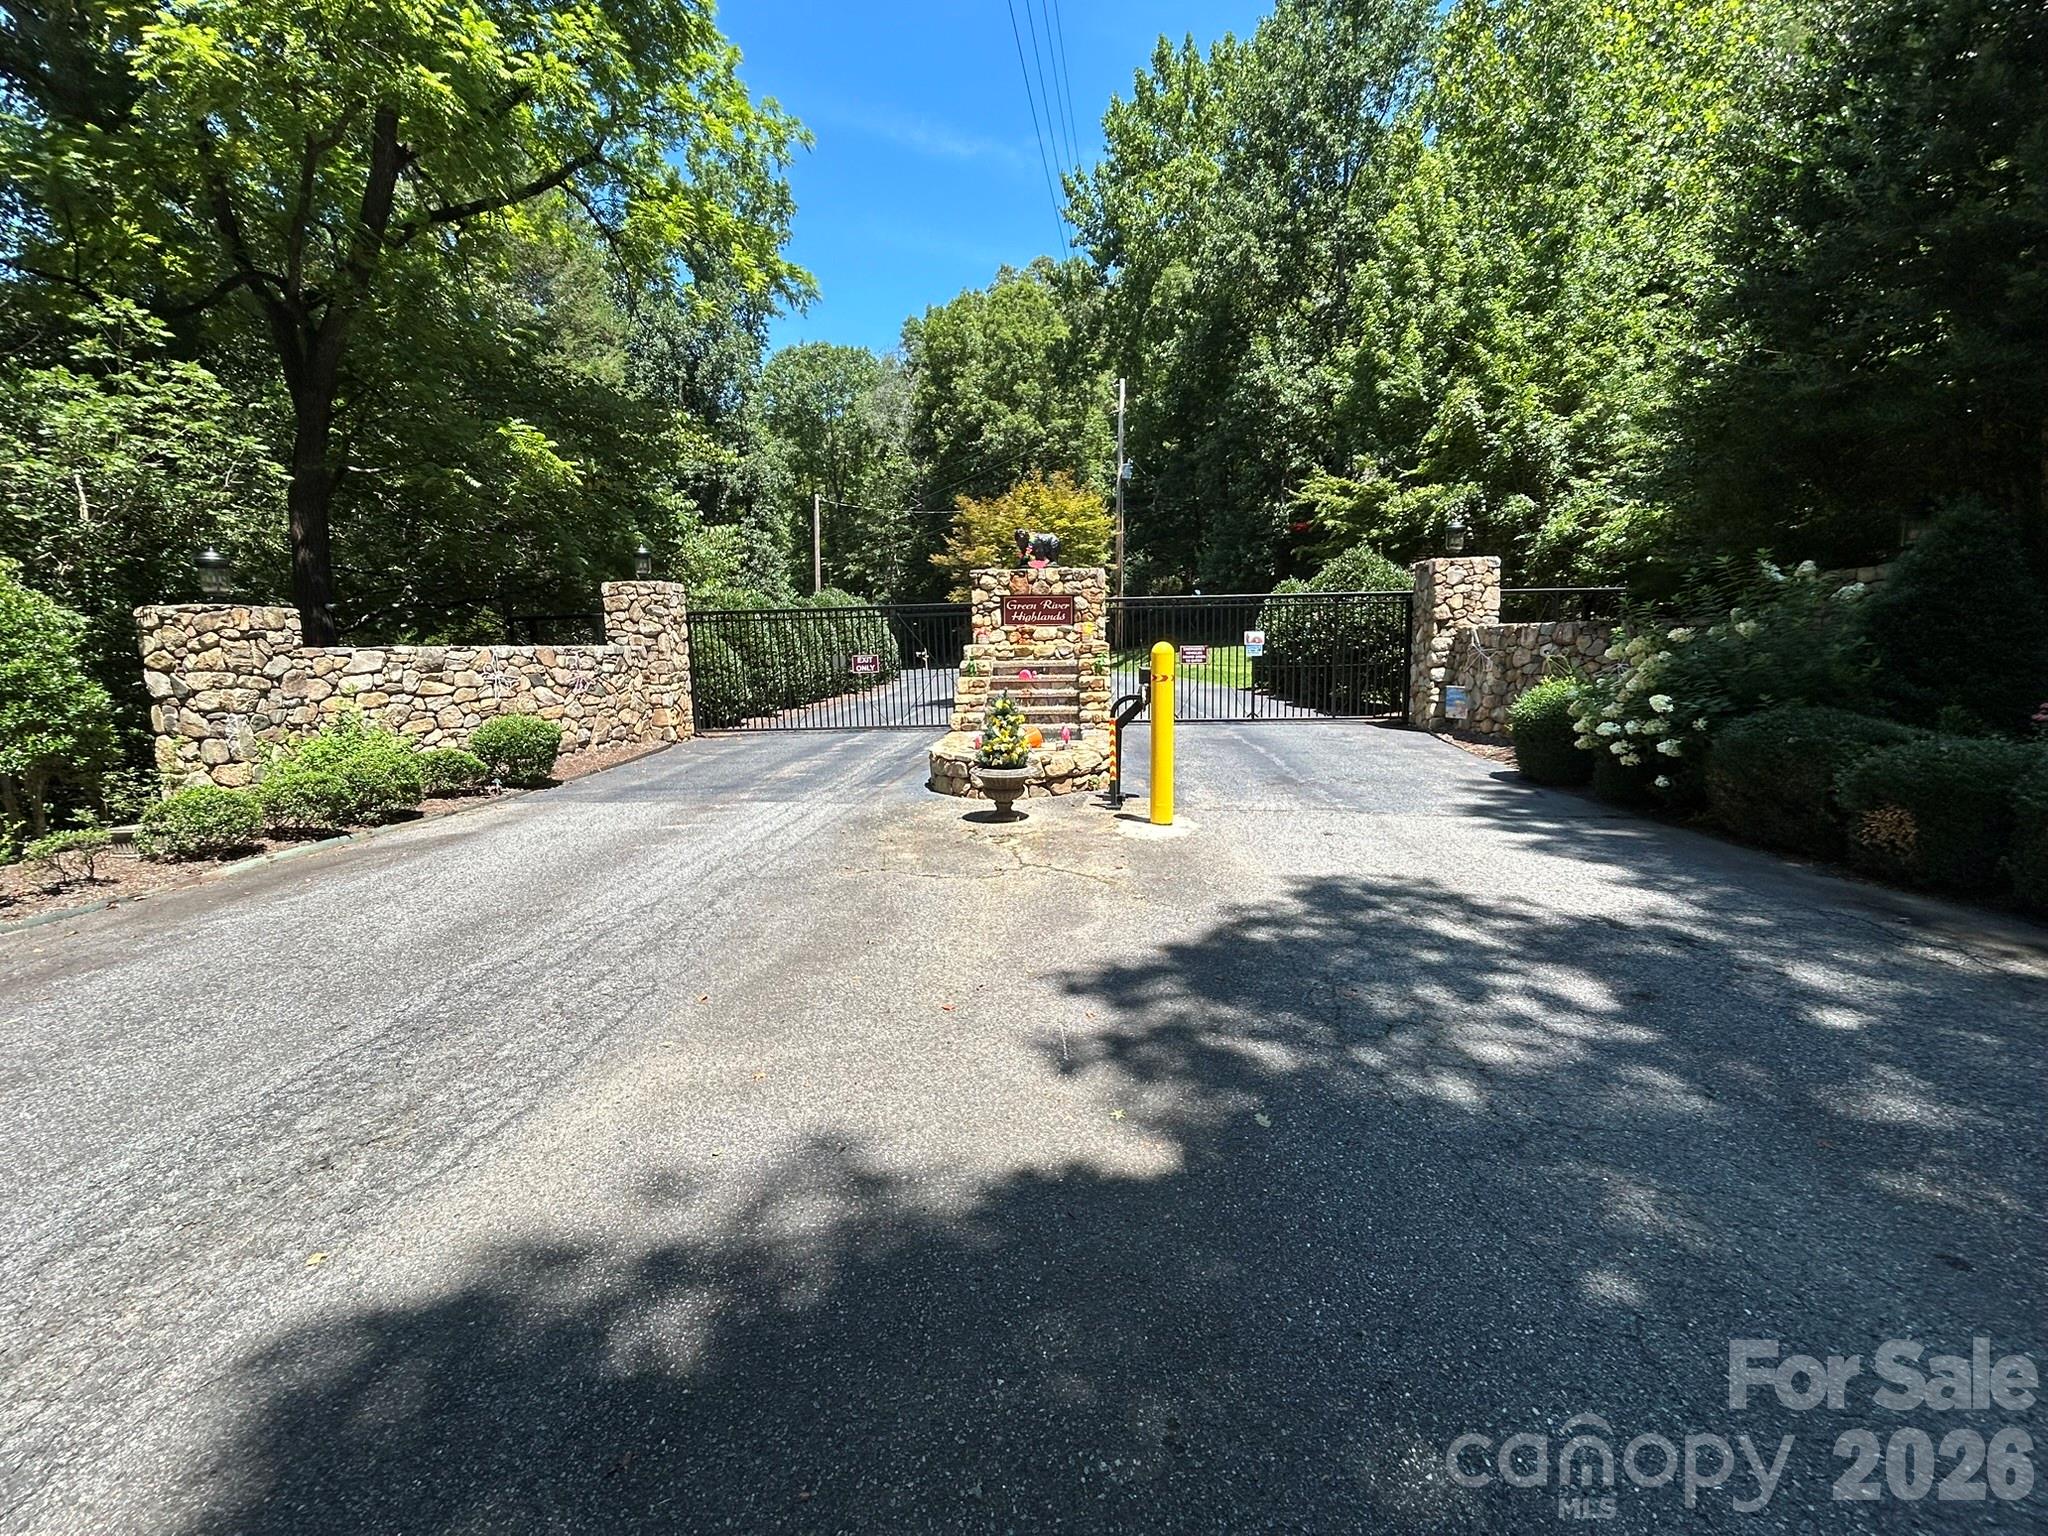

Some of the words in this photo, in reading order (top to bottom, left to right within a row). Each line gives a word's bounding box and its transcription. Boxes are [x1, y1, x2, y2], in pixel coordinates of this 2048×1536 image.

[1006, 600, 1036, 610] Green
[1040, 599, 1070, 610] River
[1011, 611, 1066, 622] Highlands
